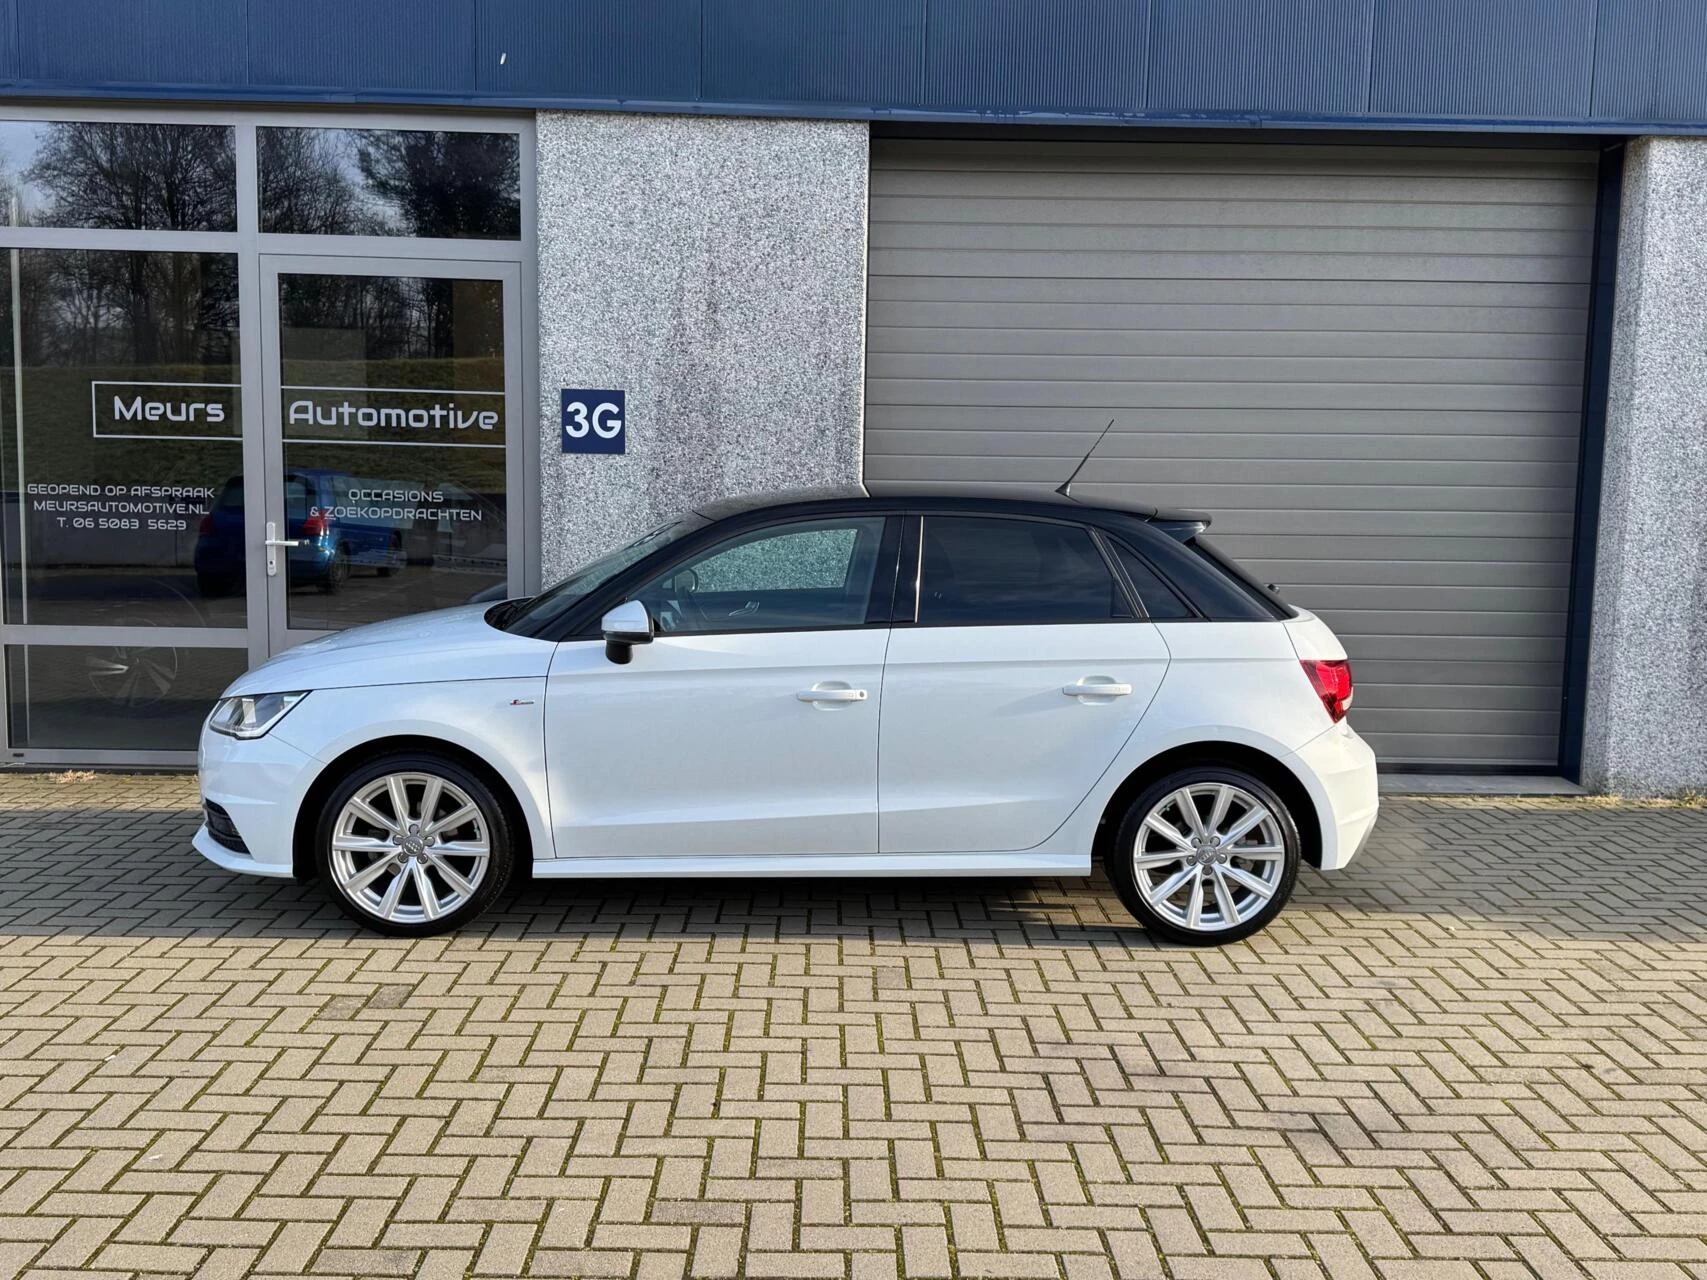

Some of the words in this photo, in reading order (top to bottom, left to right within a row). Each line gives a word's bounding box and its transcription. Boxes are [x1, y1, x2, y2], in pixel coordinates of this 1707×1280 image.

[114, 395, 225, 423] Meurs
[289, 400, 499, 430] Automotive
[565, 401, 622, 439] 3G
[27, 483, 100, 496] GEOPEND
[105, 485, 127, 497] OP
[131, 486, 215, 498] AFSPRAAK
[348, 489, 444, 503] OCCASIONS
[33, 500, 210, 515] MEURSAUTOMOTIVE.NL
[310, 506, 320, 517] &
[324, 506, 482, 521] ZOEKOPDRACHTEN
[56, 517, 69, 528] T.
[72, 517, 95, 529] 06
[98, 518, 140, 530] 5083
[147, 519, 187, 531] 5629
